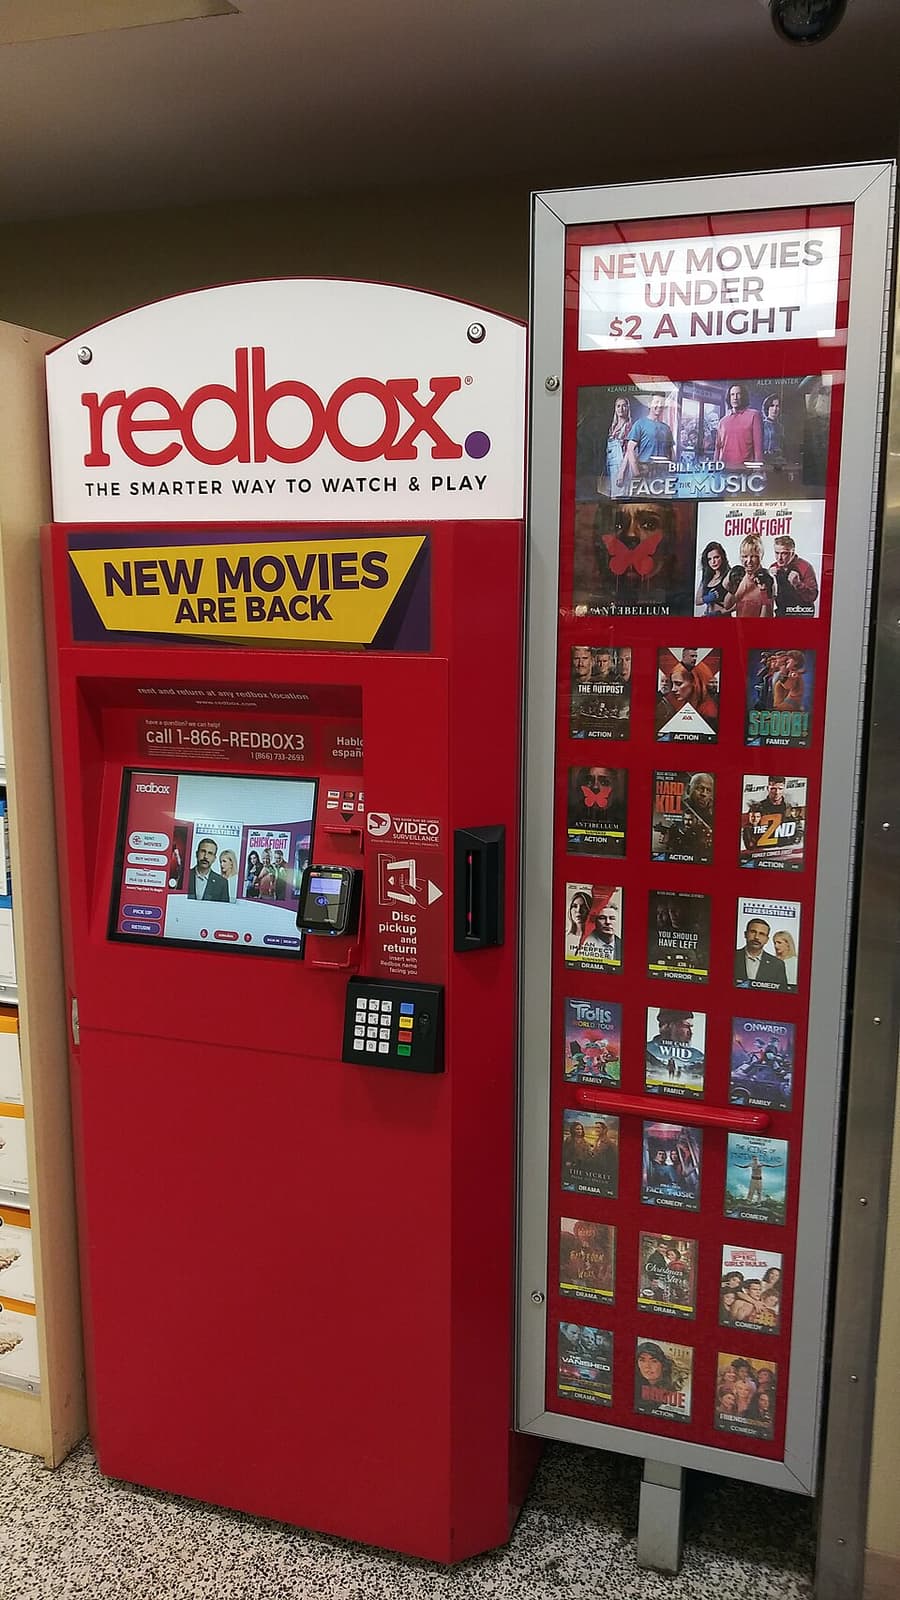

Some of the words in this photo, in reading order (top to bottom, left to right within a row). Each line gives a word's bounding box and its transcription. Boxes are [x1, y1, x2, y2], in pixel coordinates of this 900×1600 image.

[592, 250, 675, 281] NEW
[685, 240, 825, 275] MOVIES
[644, 276, 764, 308] UNDER
[608, 315, 643, 341] $2
[652, 313, 679, 339] A
[689, 306, 801, 337] NIGHT
[775, 378, 799, 386] WINTER
[668, 462, 690, 473] BILL
[700, 461, 725, 471] TED
[85, 482, 121, 497] THE
[129, 480, 223, 496] SMARTER
[232, 479, 277, 495] WAY
[286, 478, 312, 493] TO
[322, 477, 398, 493] WATCH
[408, 476, 420, 492] &
[431, 475, 488, 491] PLAY
[629, 478, 677, 497] FACE
[690, 474, 765, 495] MUSIC
[103, 557, 203, 597] NEW
[216, 551, 389, 594] MOVIES
[175, 596, 236, 624] ARE
[245, 593, 334, 623] BACK
[138, 687, 157, 695] rent
[177, 688, 205, 697] return
[235, 690, 269, 699] redbox
[270, 692, 309, 700] location
[578, 684, 591, 693] THE
[593, 685, 624, 694] OUTPOST
[748, 710, 809, 737] SCOOB!
[146, 728, 172, 744] call
[176, 728, 305, 751] 1-866-REDBOX3
[674, 733, 699, 741] ACTION
[765, 737, 790, 746] FAMILY
[255, 752, 272, 760] (866)
[273, 752, 304, 761] 733-2693
[656, 781, 684, 795] HARD
[656, 795, 683, 814] KILL
[393, 821, 439, 836] VIDEO
[753, 825, 768, 834] THE
[393, 833, 439, 843] SURVEILLANCE
[392, 911, 416, 923] Disc
[379, 922, 416, 936] pickup
[401, 936, 416, 944] and
[673, 932, 698, 941] SHOULD
[658, 938, 678, 948] HAVE
[679, 940, 698, 949] LEFT
[383, 943, 417, 955] return
[570, 945, 614, 954] IMPERFECT
[578, 951, 610, 959] MURDER
[581, 962, 604, 970] DRAMA
[390, 967, 406, 975] facing
[664, 972, 692, 980] HORROR
[751, 981, 780, 989] COMEDY
[743, 1022, 787, 1035] ONWARD
[659, 1045, 692, 1059] WILD
[582, 1076, 603, 1084] FAMILY
[663, 1087, 685, 1095] FAMILY
[748, 1098, 772, 1106] FAMILY
[578, 1185, 601, 1194] DRAMA
[656, 1198, 683, 1207] COMEDY
[740, 1212, 769, 1221] COMEDY
[576, 1291, 598, 1299] DRAMA
[653, 1306, 676, 1315] DRAMA
[735, 1321, 762, 1330] COMEDY
[561, 1356, 611, 1371] VANISHED
[574, 1393, 596, 1402] DRAMA
[651, 1409, 674, 1418] ACTION
[730, 1425, 757, 1434] COMEDY
